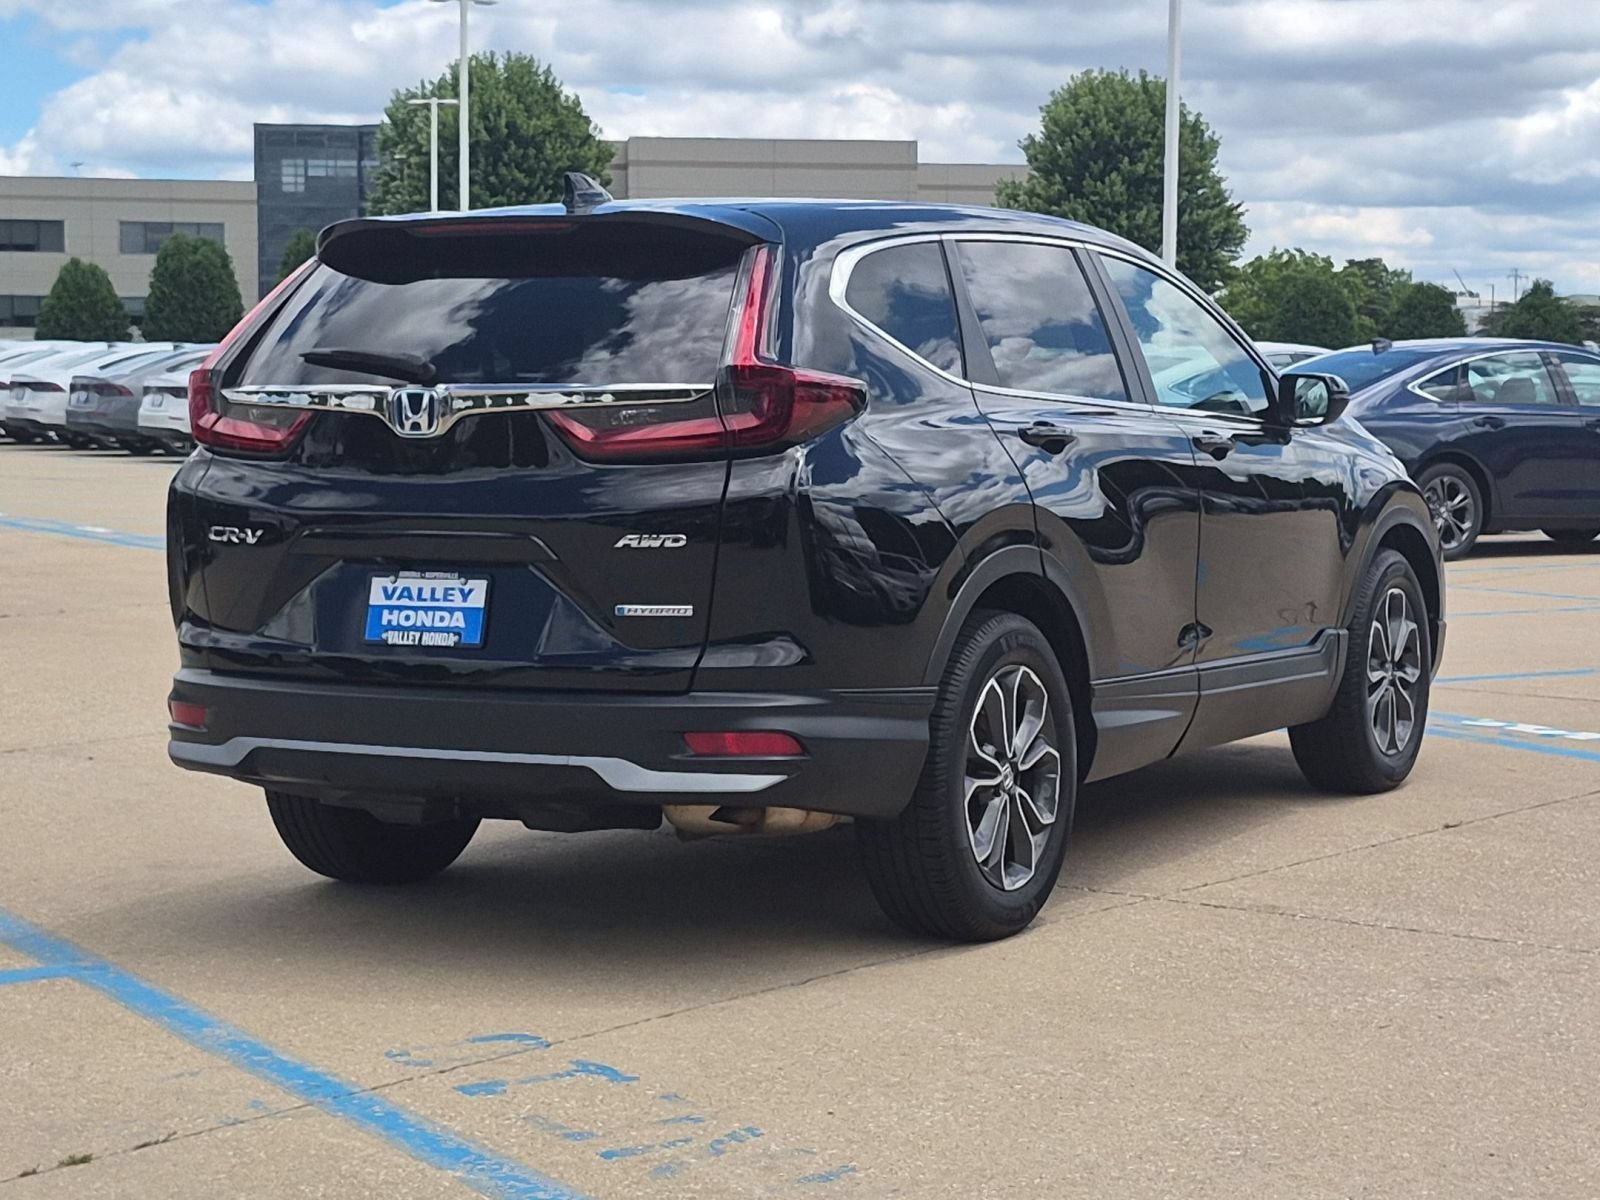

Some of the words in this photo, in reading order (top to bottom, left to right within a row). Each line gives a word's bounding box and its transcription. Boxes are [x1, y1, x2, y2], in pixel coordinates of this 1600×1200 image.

[208, 525, 264, 545] CR-V
[613, 533, 687, 549] AWD
[381, 585, 475, 603] VALLEY
[381, 608, 466, 629] HONDA
[626, 607, 689, 615] HYBRID
[387, 630, 421, 646] VALLEY
[421, 631, 456, 647] HONDA
